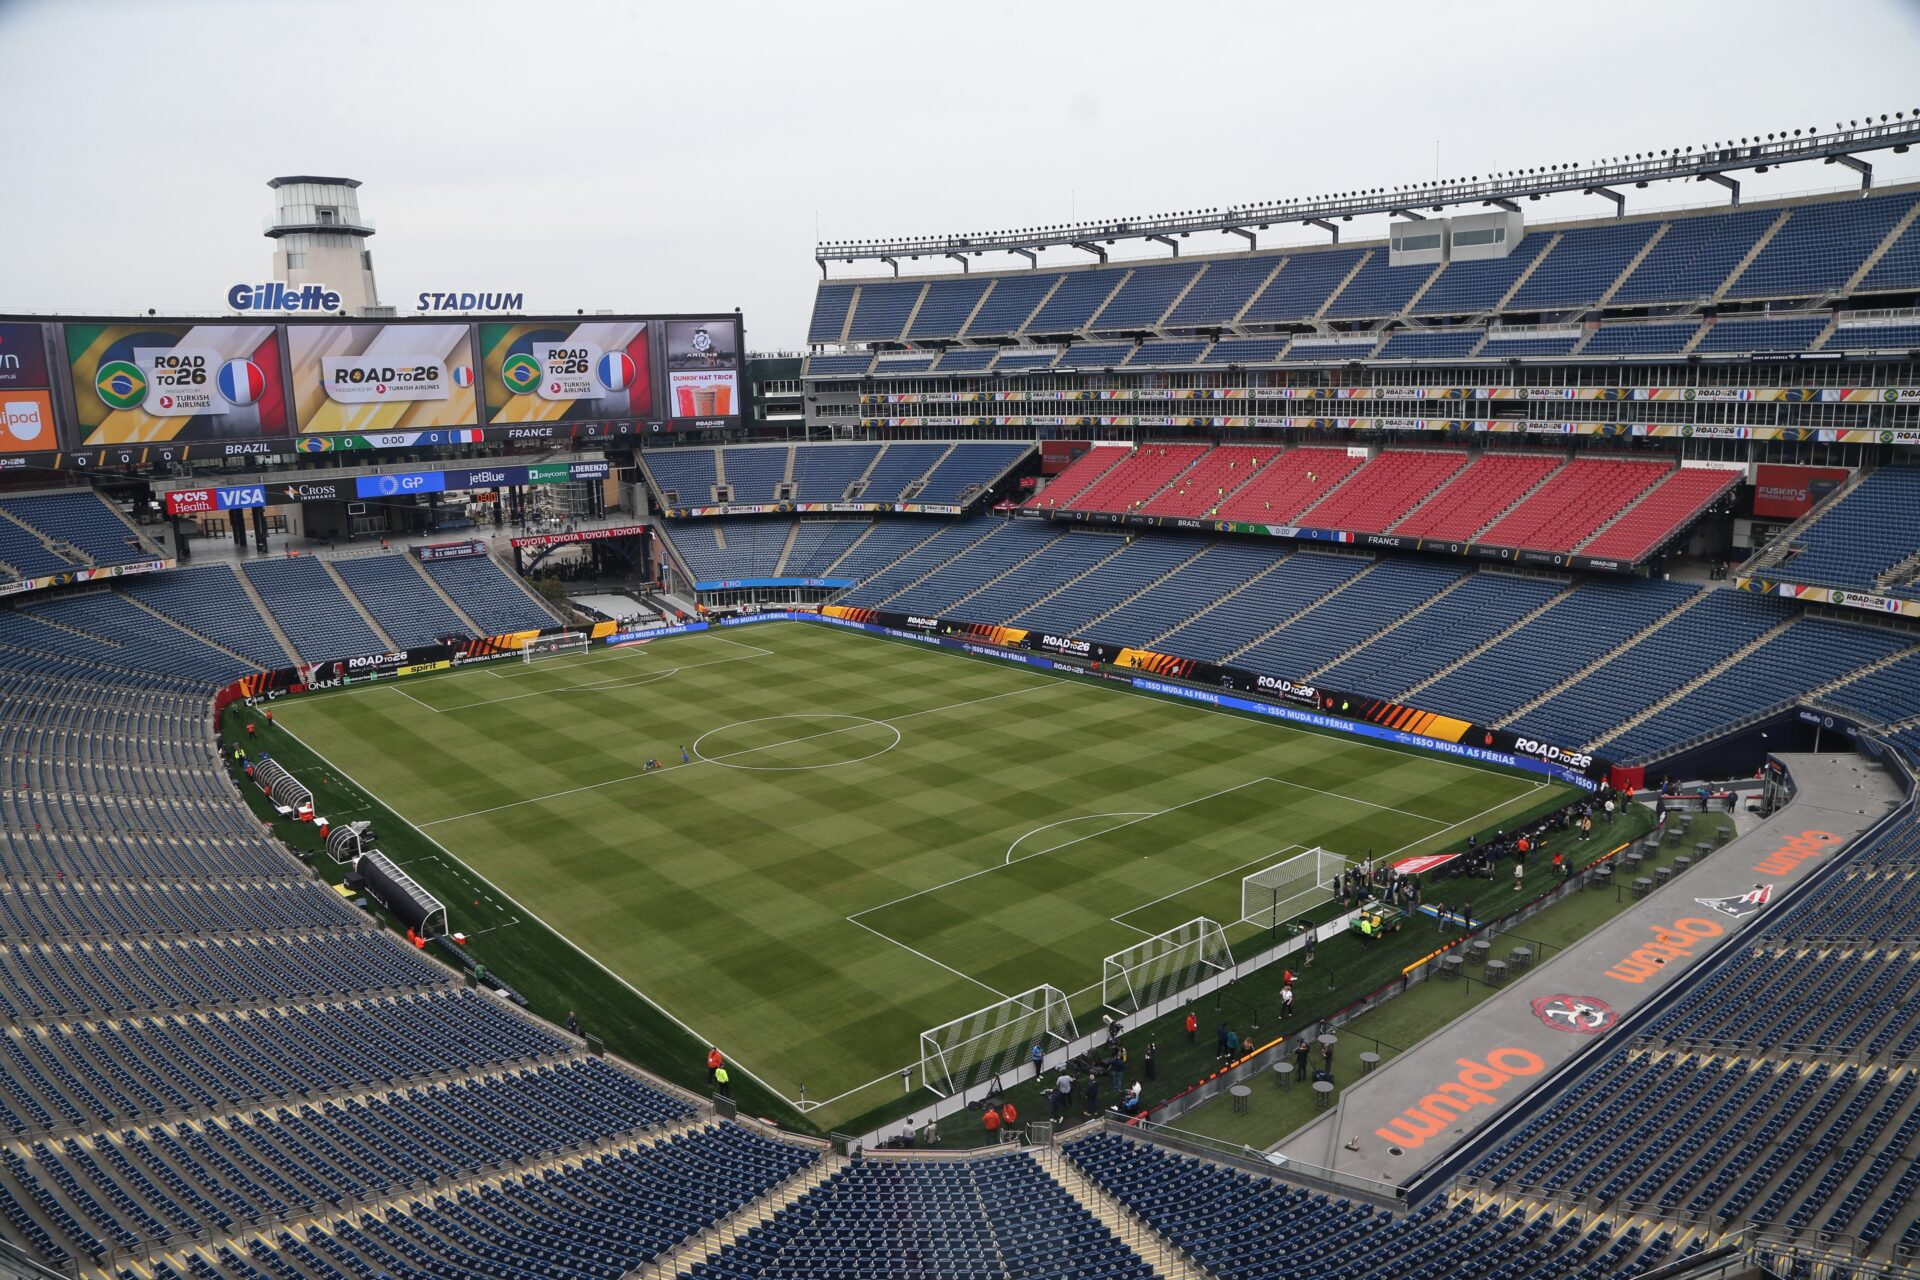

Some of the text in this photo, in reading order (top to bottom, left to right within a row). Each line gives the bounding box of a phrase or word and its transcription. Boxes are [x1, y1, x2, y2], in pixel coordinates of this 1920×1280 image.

[227, 283, 341, 312] Gillette
[417, 292, 523, 311] STADIUM
[548, 349, 588, 360] ROAD
[154, 356, 205, 368] ROAD
[549, 360, 588, 374] TO 26
[156, 368, 206, 386] TO 26
[335, 366, 439, 384] ROAD TO 26
[508, 427, 553, 438] FRANCE
[589, 427, 595, 435] 0
[621, 426, 627, 434] 0
[653, 424, 659, 432] 0
[344, 438, 352, 447] 0
[382, 436, 404, 445] 0:00
[431, 433, 438, 442] 0
[225, 443, 270, 455] BRAZIL
[121, 454, 129, 463] 0
[163, 451, 171, 460] 0
[78, 457, 86, 466] 0
[569, 463, 608, 473] J.DERENZO
[469, 471, 505, 486] jetBlue
[538, 471, 567, 480] paycom
[184, 491, 208, 501] CVS
[218, 488, 264, 506] VISA
[1076, 512, 1082, 520] 0
[1111, 514, 1117, 522] 0
[1148, 517, 1154, 525] 0
[1177, 519, 1201, 528] BRAZIL
[1249, 524, 1255, 533] 0
[516, 527, 642, 546] TOYOTA TOYOTA TOYOTA TOYOTA
[1275, 527, 1289, 535] 0:00
[1311, 530, 1317, 538] 0
[1368, 536, 1400, 546] FRANCE
[1451, 544, 1458, 552] 0
[1501, 549, 1508, 558] 0
[1525, 553, 1561, 564] CORNERS 0
[1846, 594, 1869, 603] ROAD
[1874, 598, 1885, 606] 26
[907, 616, 925, 624] ROAD
[1042, 635, 1070, 648] ROAD
[1077, 641, 1090, 651] 26
[349, 655, 384, 668] ROAD
[393, 651, 408, 661] 26
[463, 656, 491, 664] UNIVERSAL
[411, 662, 437, 674] spirit
[1054, 662, 1072, 671] ROAD
[1145, 681, 1160, 690] ISSO
[1162, 684, 1183, 695] MUDA
[1184, 689, 1193, 697] AS
[1257, 675, 1291, 692] ROAD
[1298, 685, 1315, 697] 26
[1268, 707, 1286, 718] ISSO
[1287, 710, 1311, 723] MUDA
[1313, 714, 1324, 725] AS
[1412, 737, 1433, 749] ISSO
[1435, 741, 1463, 755] MUDA
[1466, 747, 1479, 758] AS
[1481, 748, 1517, 766] FÉRIAS.
[1514, 737, 1593, 768] ROAD TO 26
[1575, 776, 1592, 790] ISSO
[1752, 829, 1843, 877] Optum
[1604, 917, 1725, 984] Optum
[1374, 1046, 1546, 1150] Optum
